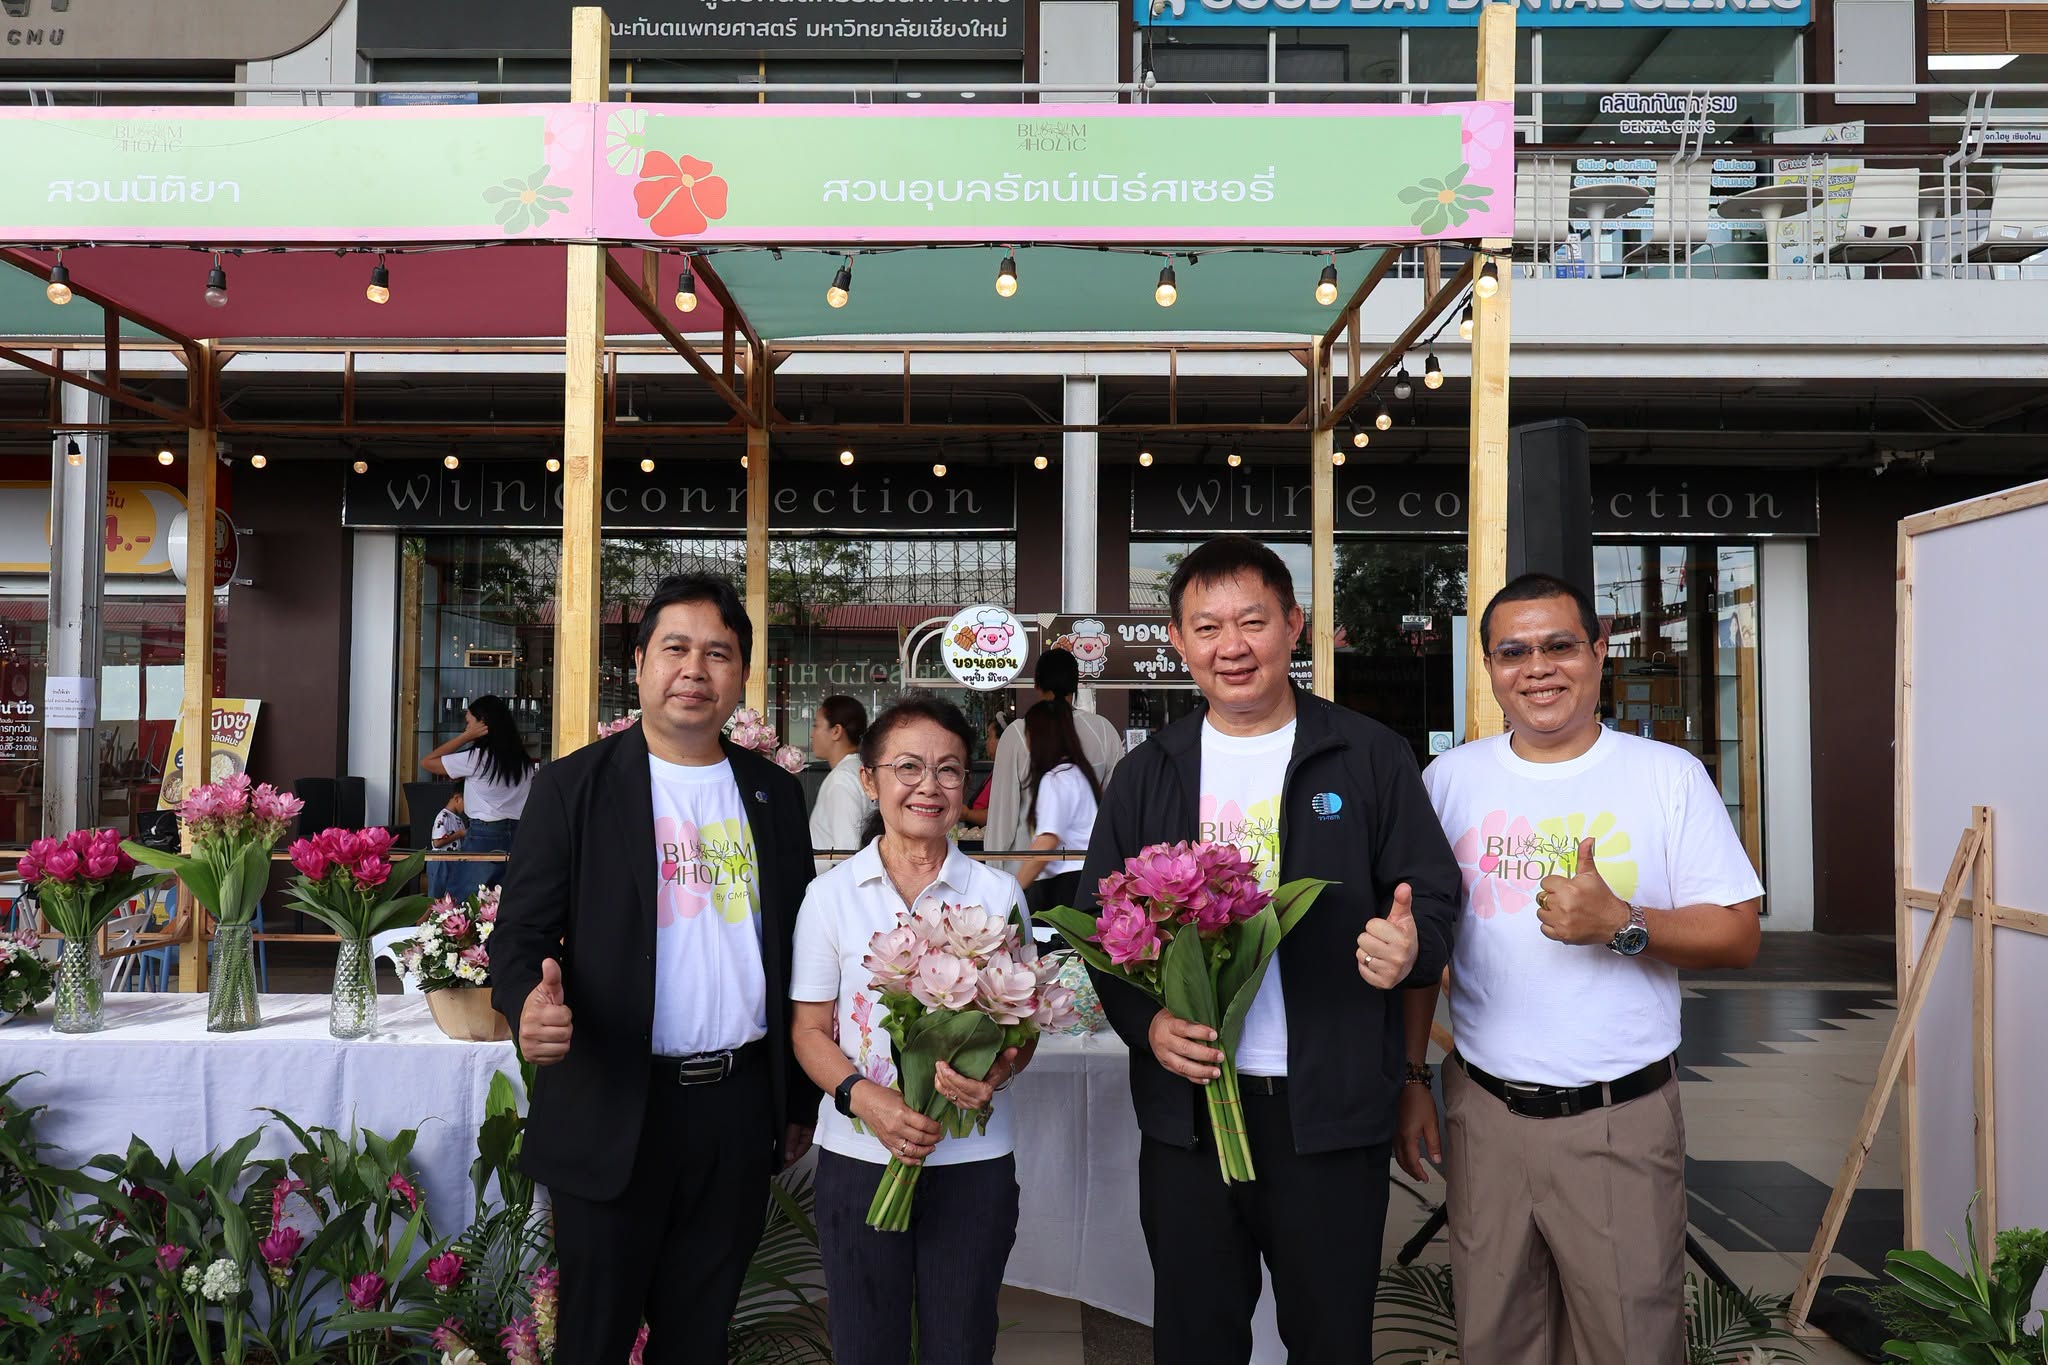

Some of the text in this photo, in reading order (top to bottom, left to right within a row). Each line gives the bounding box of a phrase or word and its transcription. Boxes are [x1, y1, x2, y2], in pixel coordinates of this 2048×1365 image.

[610, 16, 1008, 38] ณะทันตแพทยศาสตร์ มหาวิทยาลัยเชียงใหม่
[7, 29, 65, 46] CMU
[1620, 120, 1671, 133] DENTAL
[48, 174, 241, 203] สวนนิติยา
[823, 166, 1276, 211] สวนอุบลรัตน์เนิร์สเซอรี่
[1117, 624, 1169, 643] บอน
[1133, 647, 1176, 680] หมูปิ้ง
[17, 700, 35, 715] นัว
[0, 724, 31, 735] ารทุกวัน
